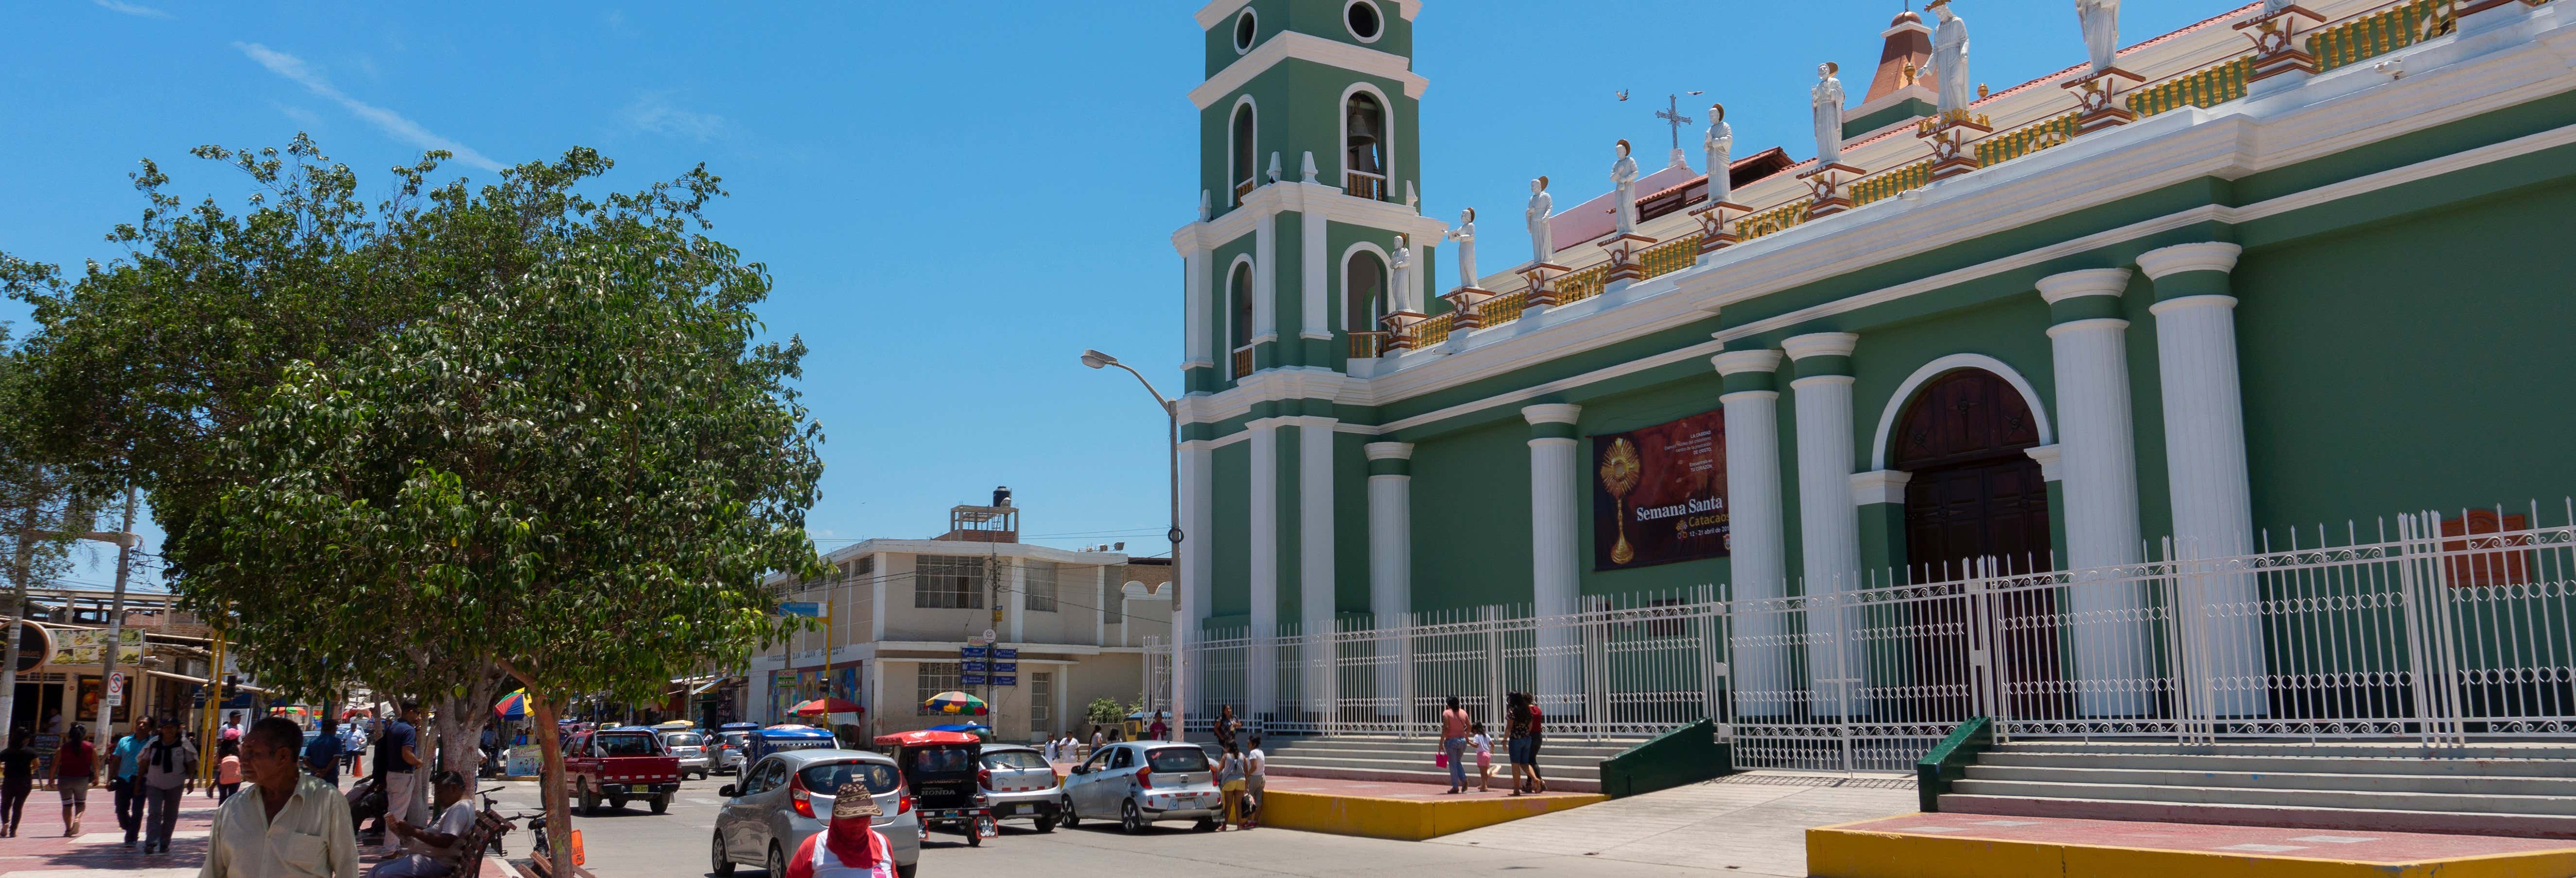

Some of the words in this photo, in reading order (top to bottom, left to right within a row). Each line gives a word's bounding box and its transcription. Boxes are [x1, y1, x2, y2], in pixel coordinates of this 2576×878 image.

[2245, 9, 2280, 24] SIMON
[2074, 72, 2098, 83] JUAN
[1926, 122, 1949, 134] JESUS
[1636, 504, 1686, 521] Semana
[1688, 495, 1723, 514] Santa
[1688, 513, 1729, 527] Catacaos
